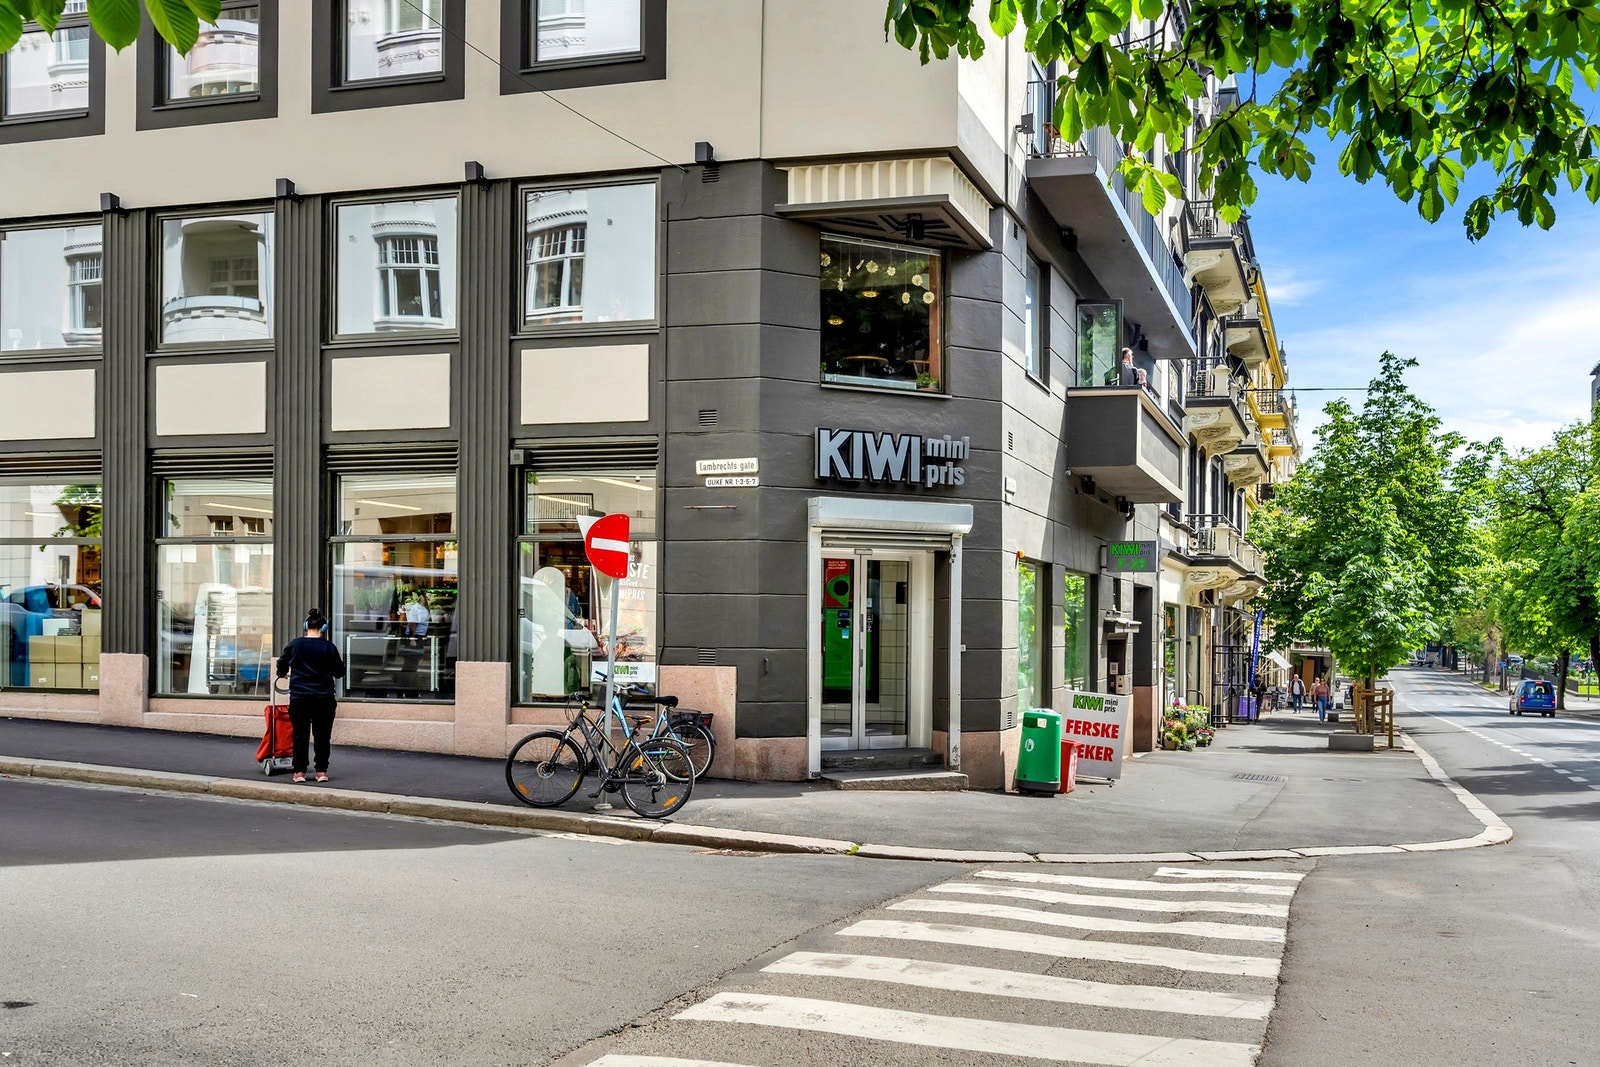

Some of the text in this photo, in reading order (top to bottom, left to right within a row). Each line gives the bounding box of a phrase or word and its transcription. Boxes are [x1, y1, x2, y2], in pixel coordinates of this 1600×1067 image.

[925, 434, 970, 459] mini
[815, 427, 922, 484] KIWI
[699, 461, 755, 472] Lambrechts gate
[925, 461, 966, 488] pris
[707, 478, 724, 486] ULIKE
[735, 478, 756, 486] 1-3-5-7
[1111, 543, 1139, 556] KIWI
[1072, 694, 1104, 711] KIWI
[1103, 705, 1117, 713] pris
[1065, 719, 1119, 739] FERSKE
[1077, 744, 1114, 762] EKER
